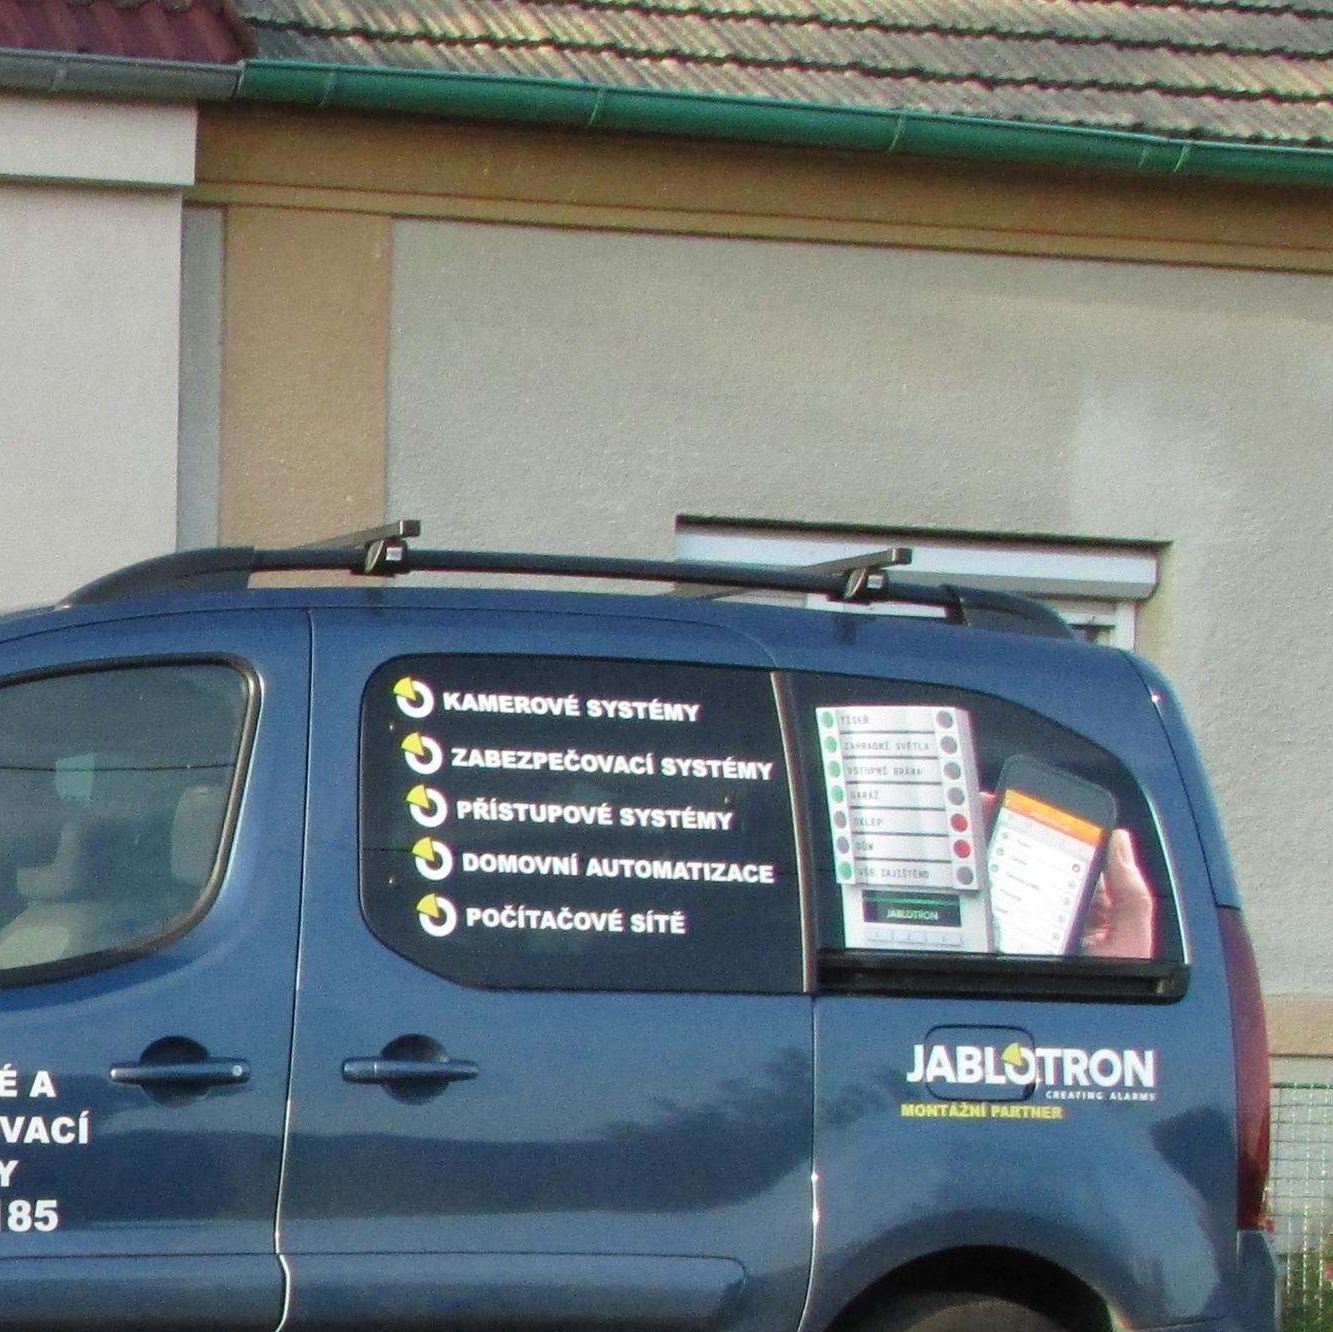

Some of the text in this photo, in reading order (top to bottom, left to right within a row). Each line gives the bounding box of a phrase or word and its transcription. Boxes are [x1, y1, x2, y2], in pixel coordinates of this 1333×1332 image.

[443, 692, 700, 722] KAMEROVÉ SYSTÉMY
[451, 748, 774, 780] ZABEZPEČOVACÍ SYSTÉMY
[456, 798, 733, 830] PŘÍSTUPOVÉ SYSTÉMY
[462, 853, 774, 884] DOMOVNÍ AUTOMATIZACE
[466, 906, 686, 934] POČÍTAČOVÉ SÍTĚ
[907, 1043, 1155, 1088] JABLOTRON
[29, 1071, 56, 1098] A
[1045, 1090, 1155, 1101] CREATING ALARMS
[991, 1104, 1063, 1119] PARTNER
